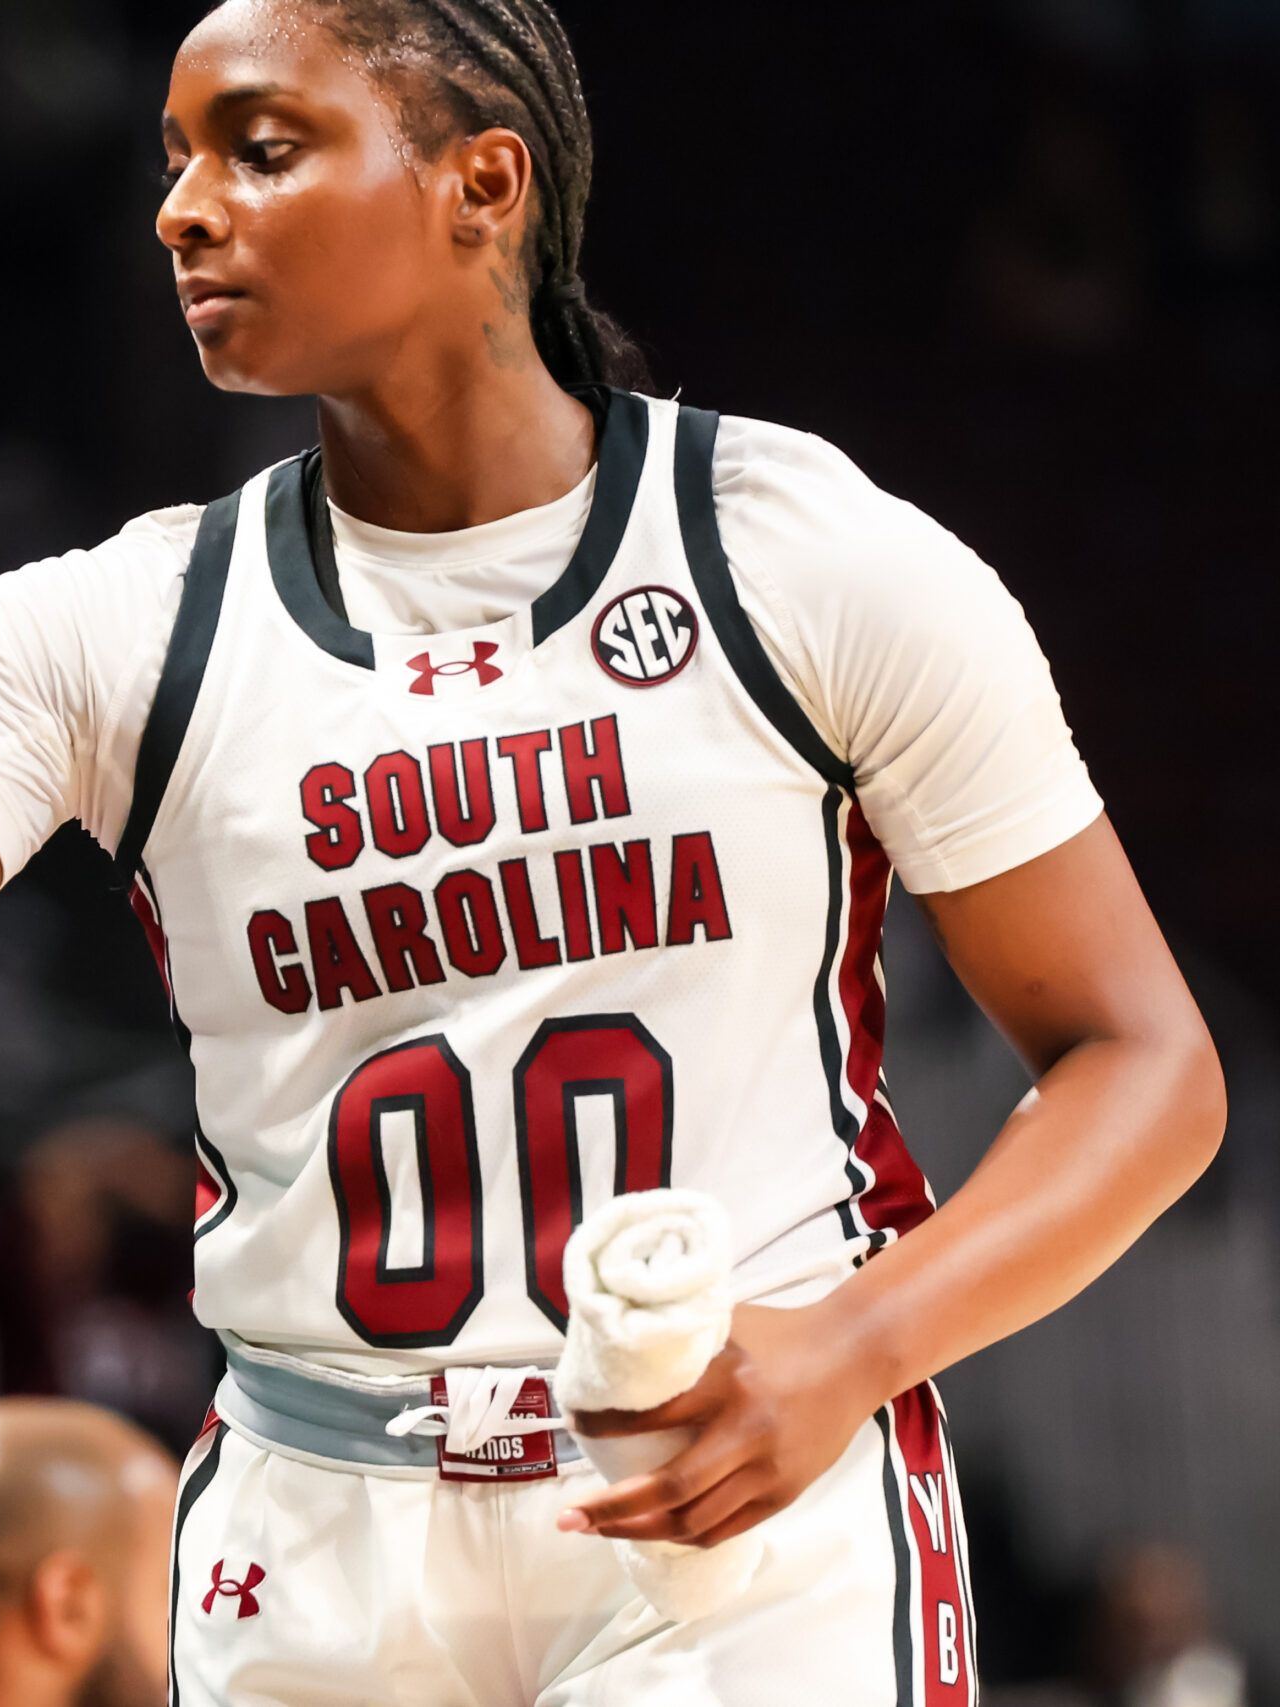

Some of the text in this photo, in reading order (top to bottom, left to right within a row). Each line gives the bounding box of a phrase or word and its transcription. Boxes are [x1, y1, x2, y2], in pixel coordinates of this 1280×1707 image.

[599, 591, 690, 680] SEC
[300, 713, 631, 871] SOUTH
[247, 831, 732, 1014] CAROLINA
[328, 1012, 674, 1348] 00
